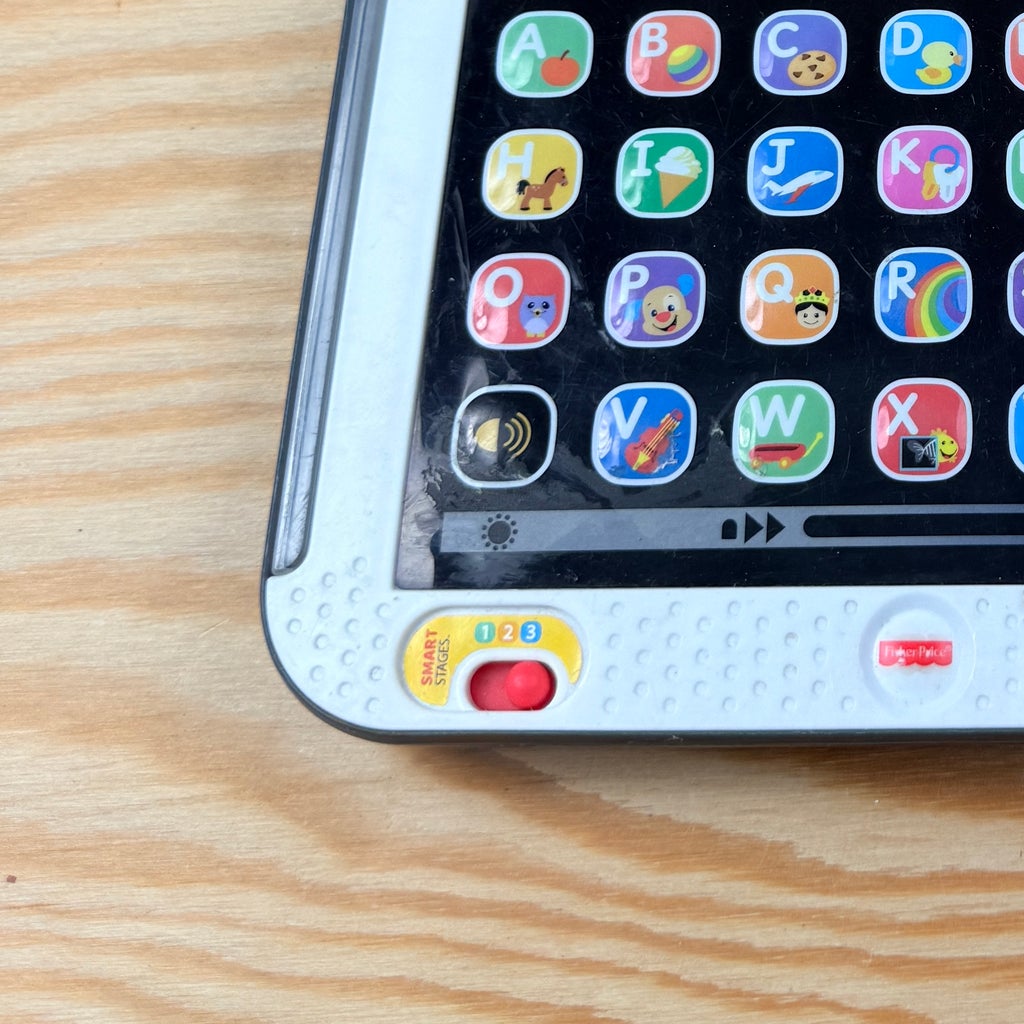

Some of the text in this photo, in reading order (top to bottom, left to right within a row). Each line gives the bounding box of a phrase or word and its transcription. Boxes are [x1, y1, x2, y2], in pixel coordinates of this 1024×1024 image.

[510, 23, 546, 59] A
[639, 22, 668, 58] B
[767, 21, 799, 58] C
[893, 22, 923, 56] D
[500, 142, 534, 178] H
[630, 140, 655, 177] I
[762, 139, 795, 176] J
[890, 138, 921, 175] K
[484, 266, 523, 307] O
[620, 265, 650, 304] P
[755, 263, 793, 303] Q
[888, 261, 917, 300] R
[610, 396, 647, 439] V
[750, 394, 806, 437] W
[887, 393, 919, 436] X
[502, 623, 514, 640] 2
[526, 624, 536, 639] 3
[421, 628, 438, 686] SMART
